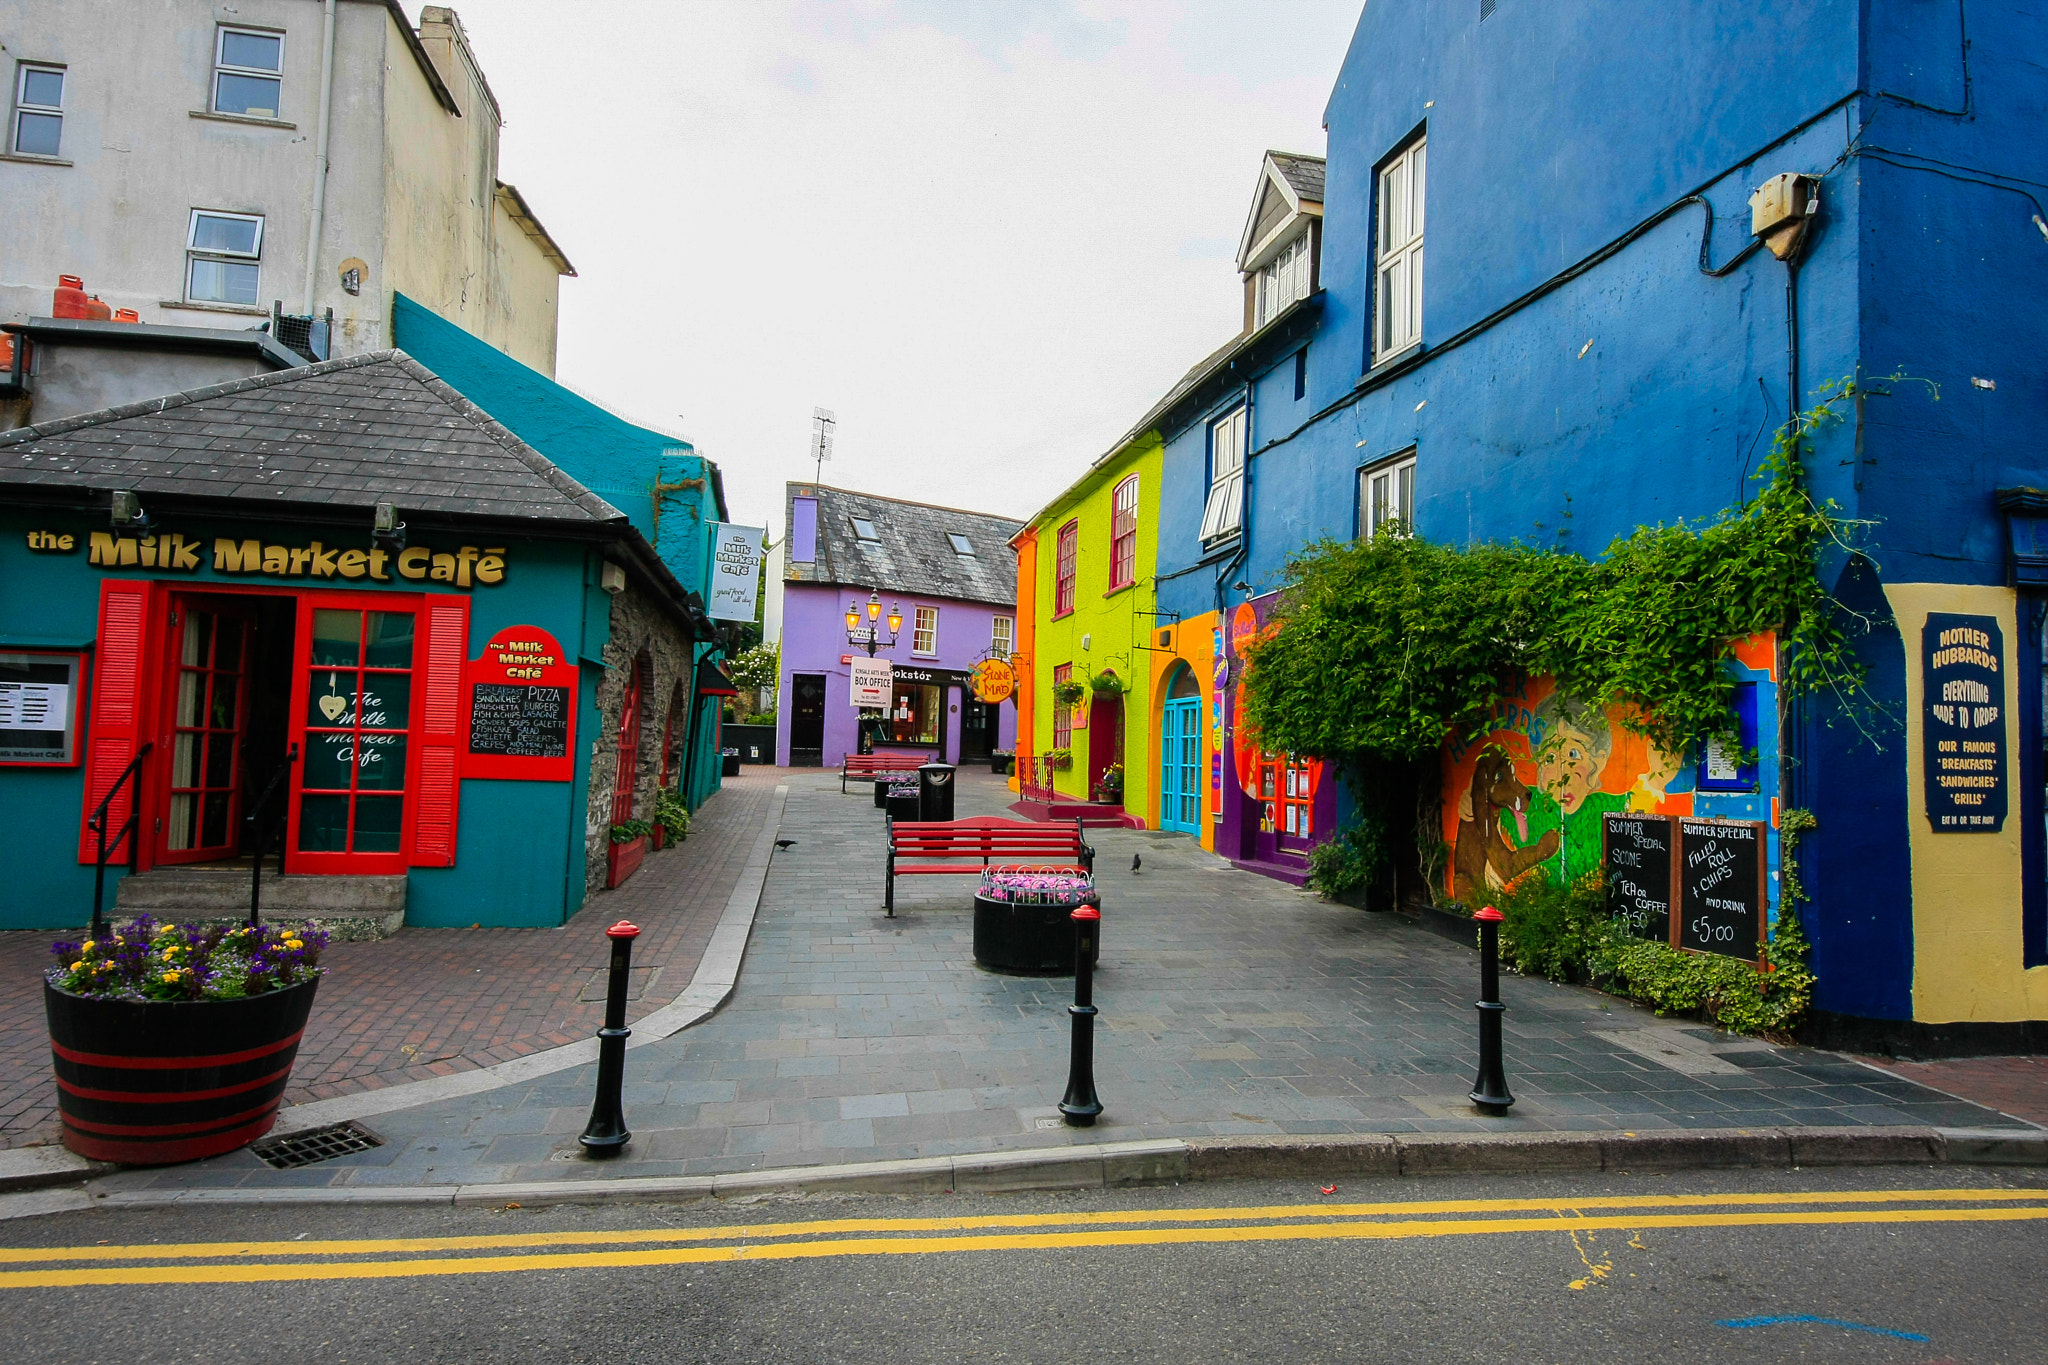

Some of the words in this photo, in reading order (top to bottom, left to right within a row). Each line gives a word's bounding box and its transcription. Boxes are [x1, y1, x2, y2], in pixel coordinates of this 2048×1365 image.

[27, 530, 74, 550] the
[89, 531, 201, 570] Milk
[213, 538, 389, 580] Market
[724, 542, 751, 555] Milk
[716, 552, 759, 566] Market
[716, 588, 731, 598] great
[729, 587, 746, 599] food
[742, 595, 752, 607] day
[1940, 627, 1989, 650] MOTHER
[509, 641, 543, 652] Milk
[499, 653, 554, 666] Market
[1932, 646, 1998, 672] HUBBARDS
[984, 665, 1010, 681] STONE
[855, 676, 868, 686] BOX
[870, 677, 891, 688] OFFICE
[983, 682, 1010, 696] MAD
[476, 684, 524, 696] BREAKFAST
[528, 686, 560, 702] PIZZA
[1943, 679, 1989, 703] EVERYTHING
[350, 692, 383, 707] The
[476, 695, 521, 703] SANDWICHES
[524, 701, 560, 712] BURGERS
[336, 711, 387, 725] Milk
[473, 710, 491, 719] FISH
[500, 711, 521, 719] CHIPS
[522, 710, 558, 719] LASAGNE
[1933, 704, 1954, 726] MADE
[1958, 706, 1969, 729] TO
[1973, 706, 1998, 728] ORDER
[471, 718, 506, 726] CHOWDER
[508, 719, 530, 727] SOUPS
[533, 719, 567, 728] GALETTE
[471, 732, 512, 740] OMELETTE
[517, 733, 558, 743] DESSERTS
[517, 726, 540, 735] SALAD
[1448, 703, 1546, 764] HARDS
[471, 739, 506, 749] CREPES
[1938, 740, 1957, 752] OUR
[1963, 741, 1996, 753] FAMOUS
[506, 747, 541, 756] COFFEES
[543, 749, 564, 758] BEER
[1603, 811, 1627, 819] MOTHER
[1628, 812, 1666, 821] HUBBARDS
[1678, 816, 1705, 824] MOTHER
[1709, 817, 1752, 827] HUBBARDS
[1941, 815, 1950, 825] EAT
[1951, 815, 1957, 825] IN
[1960, 815, 1967, 825] OR
[1969, 815, 1981, 825] TAKE
[1982, 815, 1995, 825] AWAY
[1609, 819, 1643, 836] SUMMER
[1683, 823, 1716, 837] SUMMER
[1717, 826, 1755, 840] SPECIAL
[1633, 835, 1666, 852] SPECIAL
[1612, 848, 1642, 868] SCONE
[1688, 840, 1717, 868] FILLED
[1707, 847, 1736, 869] ROLL
[1700, 865, 1733, 891] CHIPS
[1620, 880, 1637, 896] TEA
[1637, 888, 1647, 898] OR
[1635, 897, 1668, 915] COFFEE
[1705, 897, 1721, 909] AND
[1722, 899, 1747, 915] DRINK
